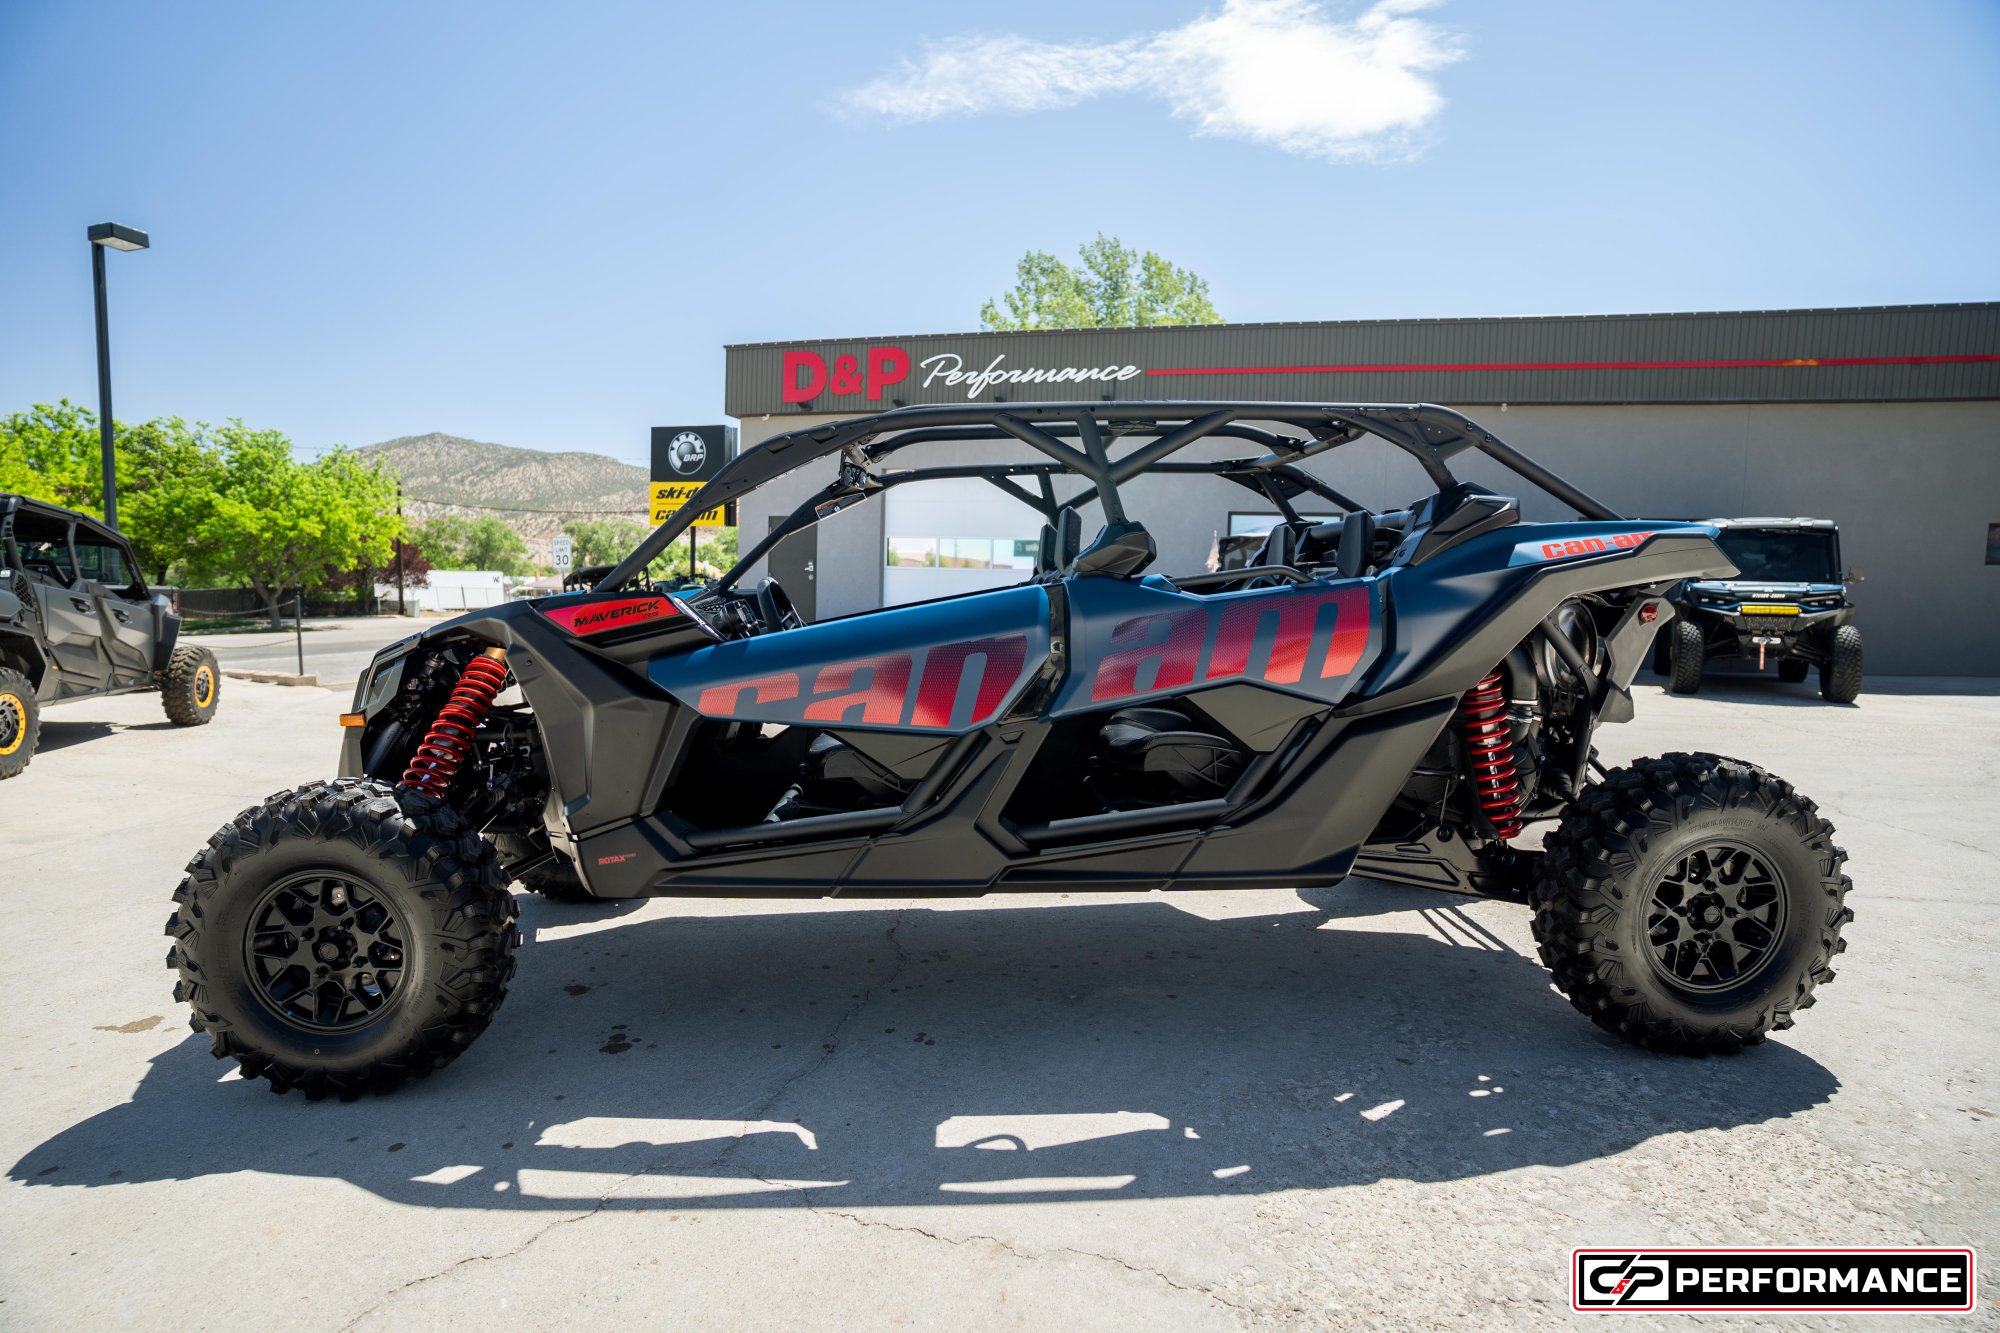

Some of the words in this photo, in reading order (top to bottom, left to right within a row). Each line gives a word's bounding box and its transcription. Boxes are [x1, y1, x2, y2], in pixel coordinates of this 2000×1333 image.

[783, 347, 910, 403] D&P
[920, 353, 1141, 399] Performance
[683, 453, 704, 462] BRP
[656, 486, 701, 499] ski-d
[555, 554, 569, 566] 30
[574, 600, 659, 627] MAVERICK
[598, 855, 625, 865] ROTAX
